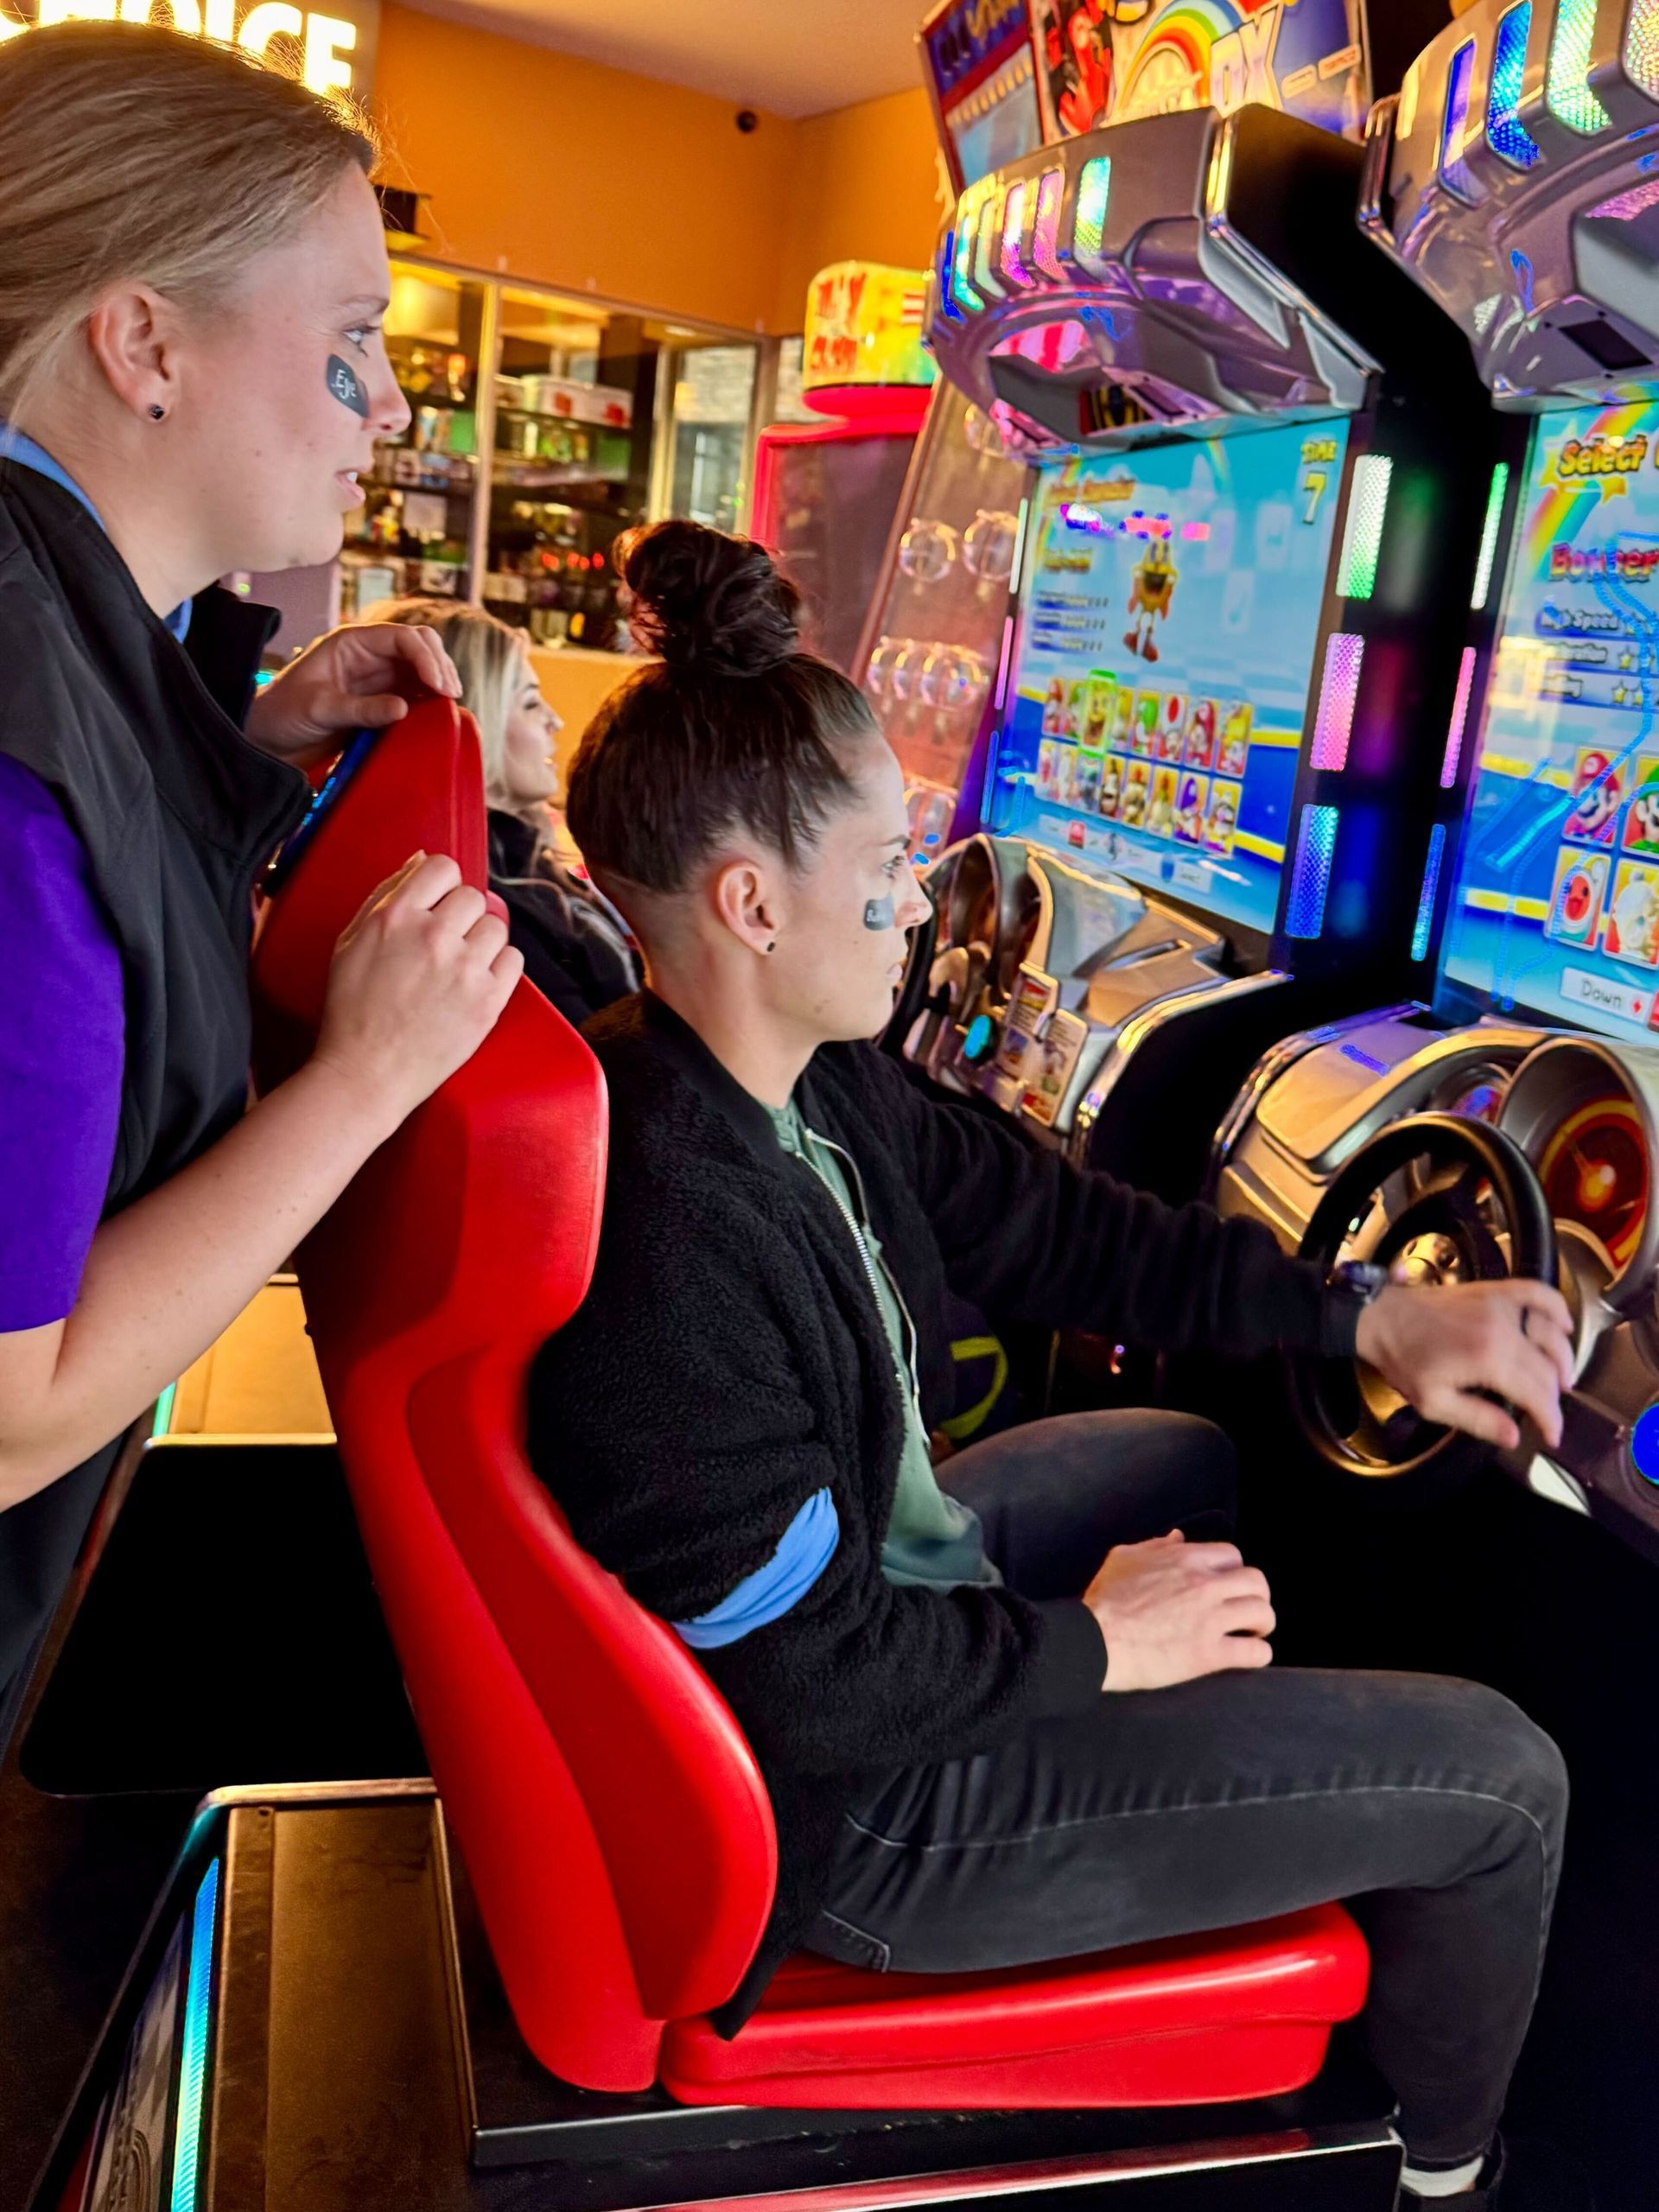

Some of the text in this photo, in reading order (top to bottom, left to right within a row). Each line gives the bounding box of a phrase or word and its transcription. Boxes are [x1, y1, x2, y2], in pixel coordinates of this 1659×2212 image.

[0, 0, 357, 97] ICE
[1558, 434, 1649, 477] Select
[1303, 471, 1327, 524] 7
[1550, 542, 1659, 583] Boer
[1581, 978, 1623, 1008] Down
